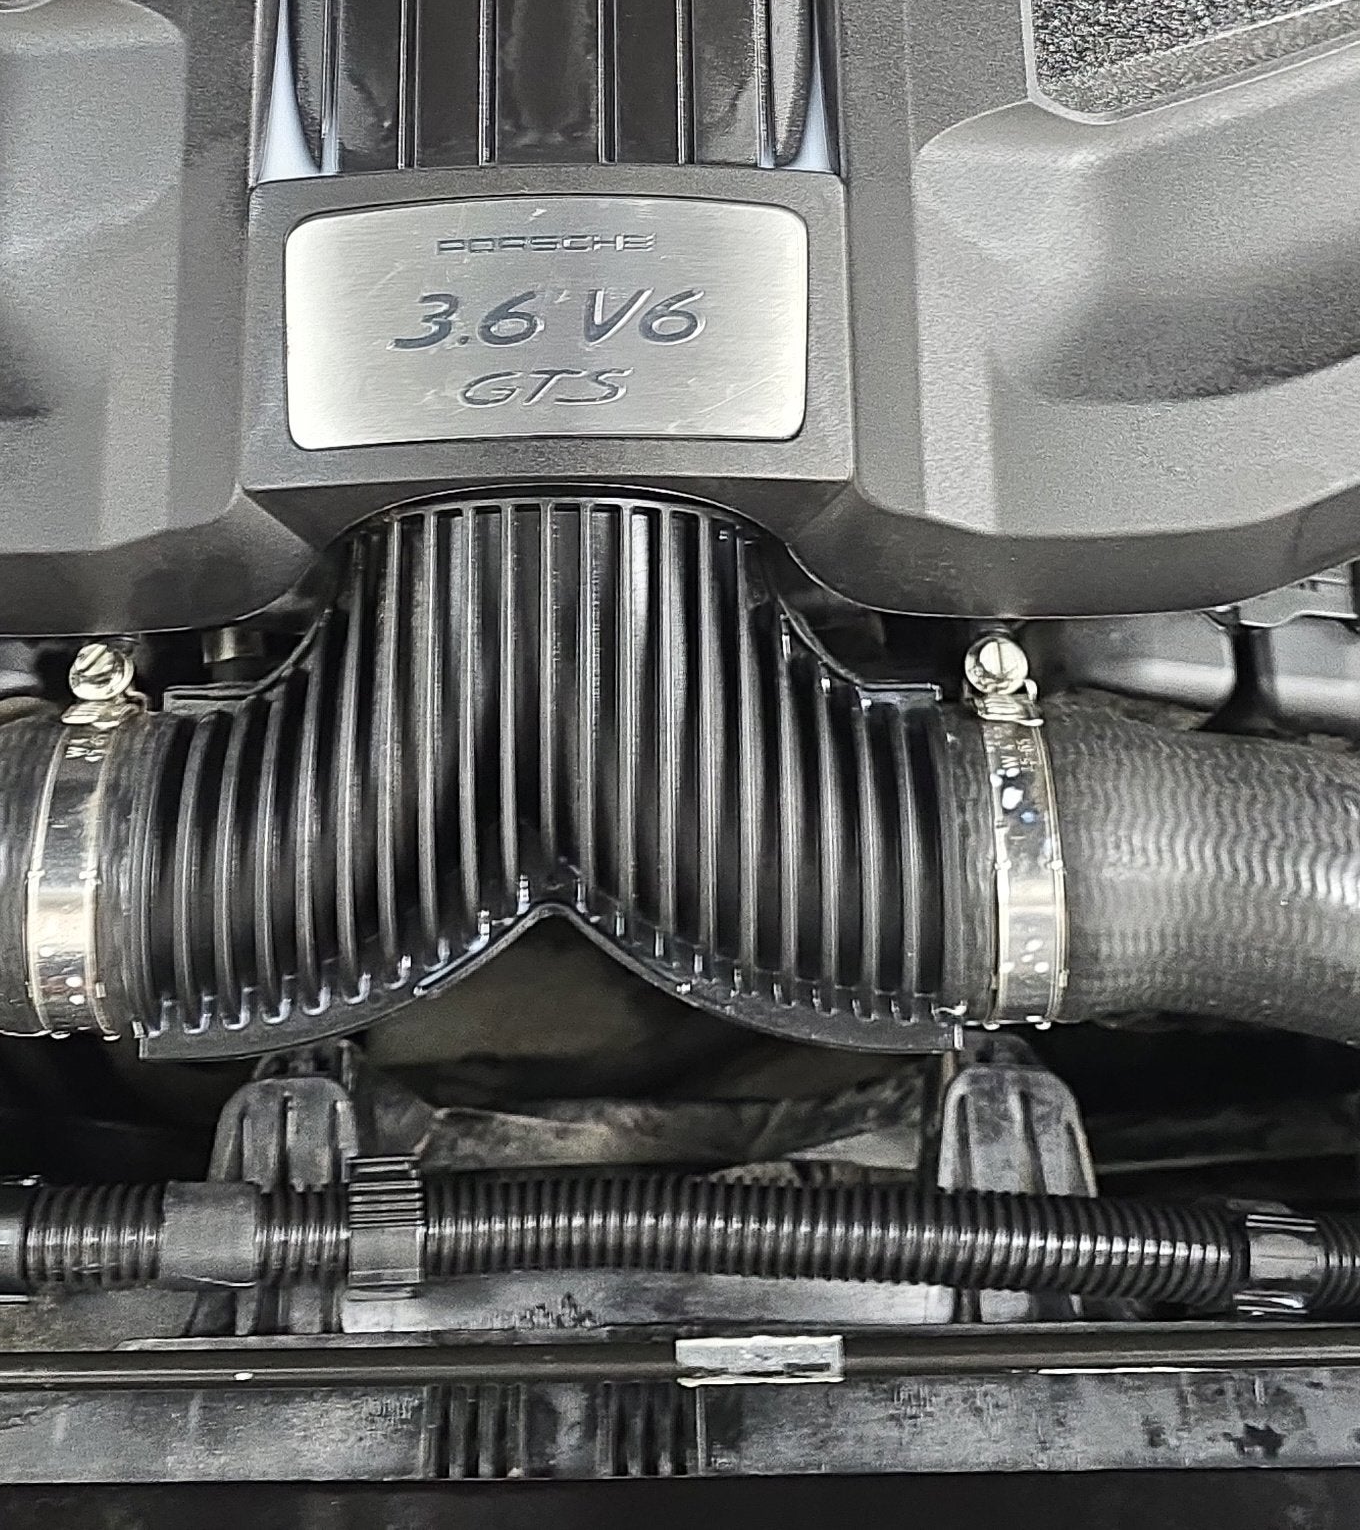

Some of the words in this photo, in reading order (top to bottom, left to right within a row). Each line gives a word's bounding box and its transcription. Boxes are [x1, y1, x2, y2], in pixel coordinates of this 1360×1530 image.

[436, 232, 657, 255] PORSCHE
[386, 290, 544, 350] 3.6
[583, 287, 706, 350] V6
[457, 367, 635, 409] GTS
